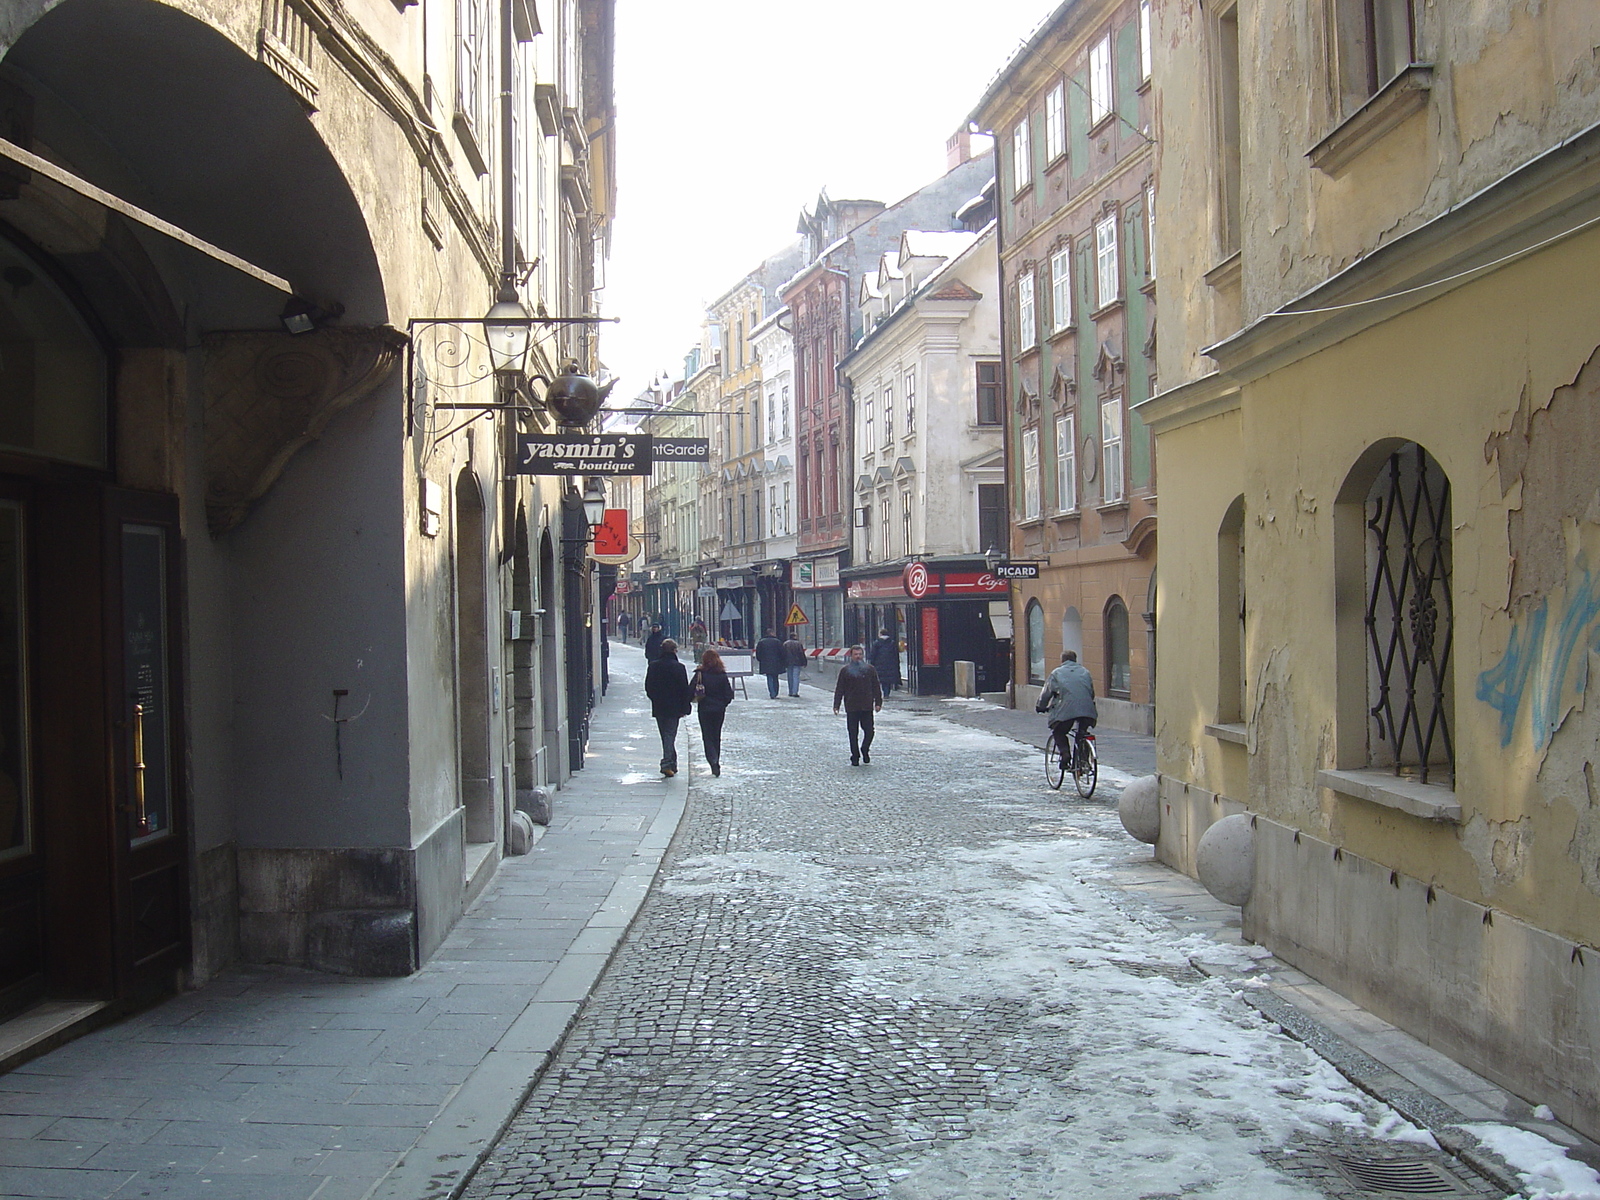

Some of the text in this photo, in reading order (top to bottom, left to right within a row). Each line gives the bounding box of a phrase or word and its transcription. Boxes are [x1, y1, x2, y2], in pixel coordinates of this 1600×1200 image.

[523, 437, 635, 464] yasmin's
[578, 459, 635, 473] boutique
[997, 566, 1036, 576] PICARD
